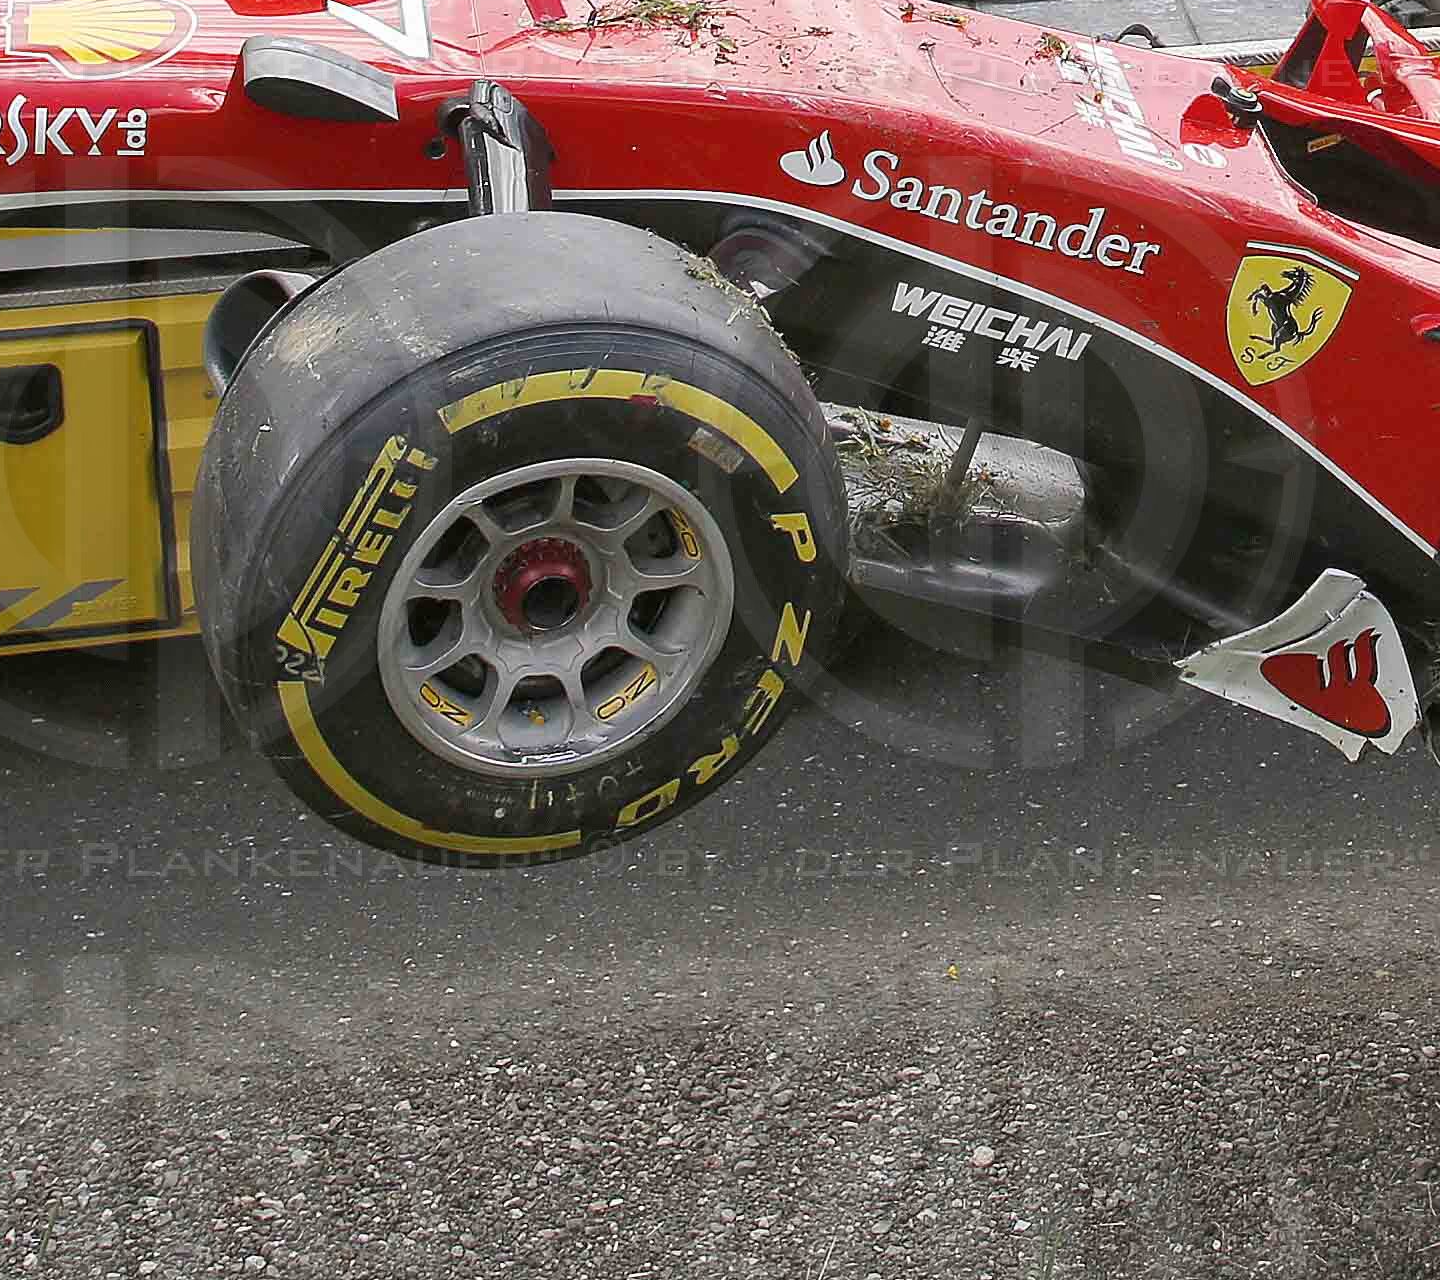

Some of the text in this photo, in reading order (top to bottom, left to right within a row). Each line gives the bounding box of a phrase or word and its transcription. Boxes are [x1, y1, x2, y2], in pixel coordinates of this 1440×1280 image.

[117, 108, 147, 156] lab
[851, 149, 1160, 275] Santander
[890, 282, 1092, 361] WEICHAI
